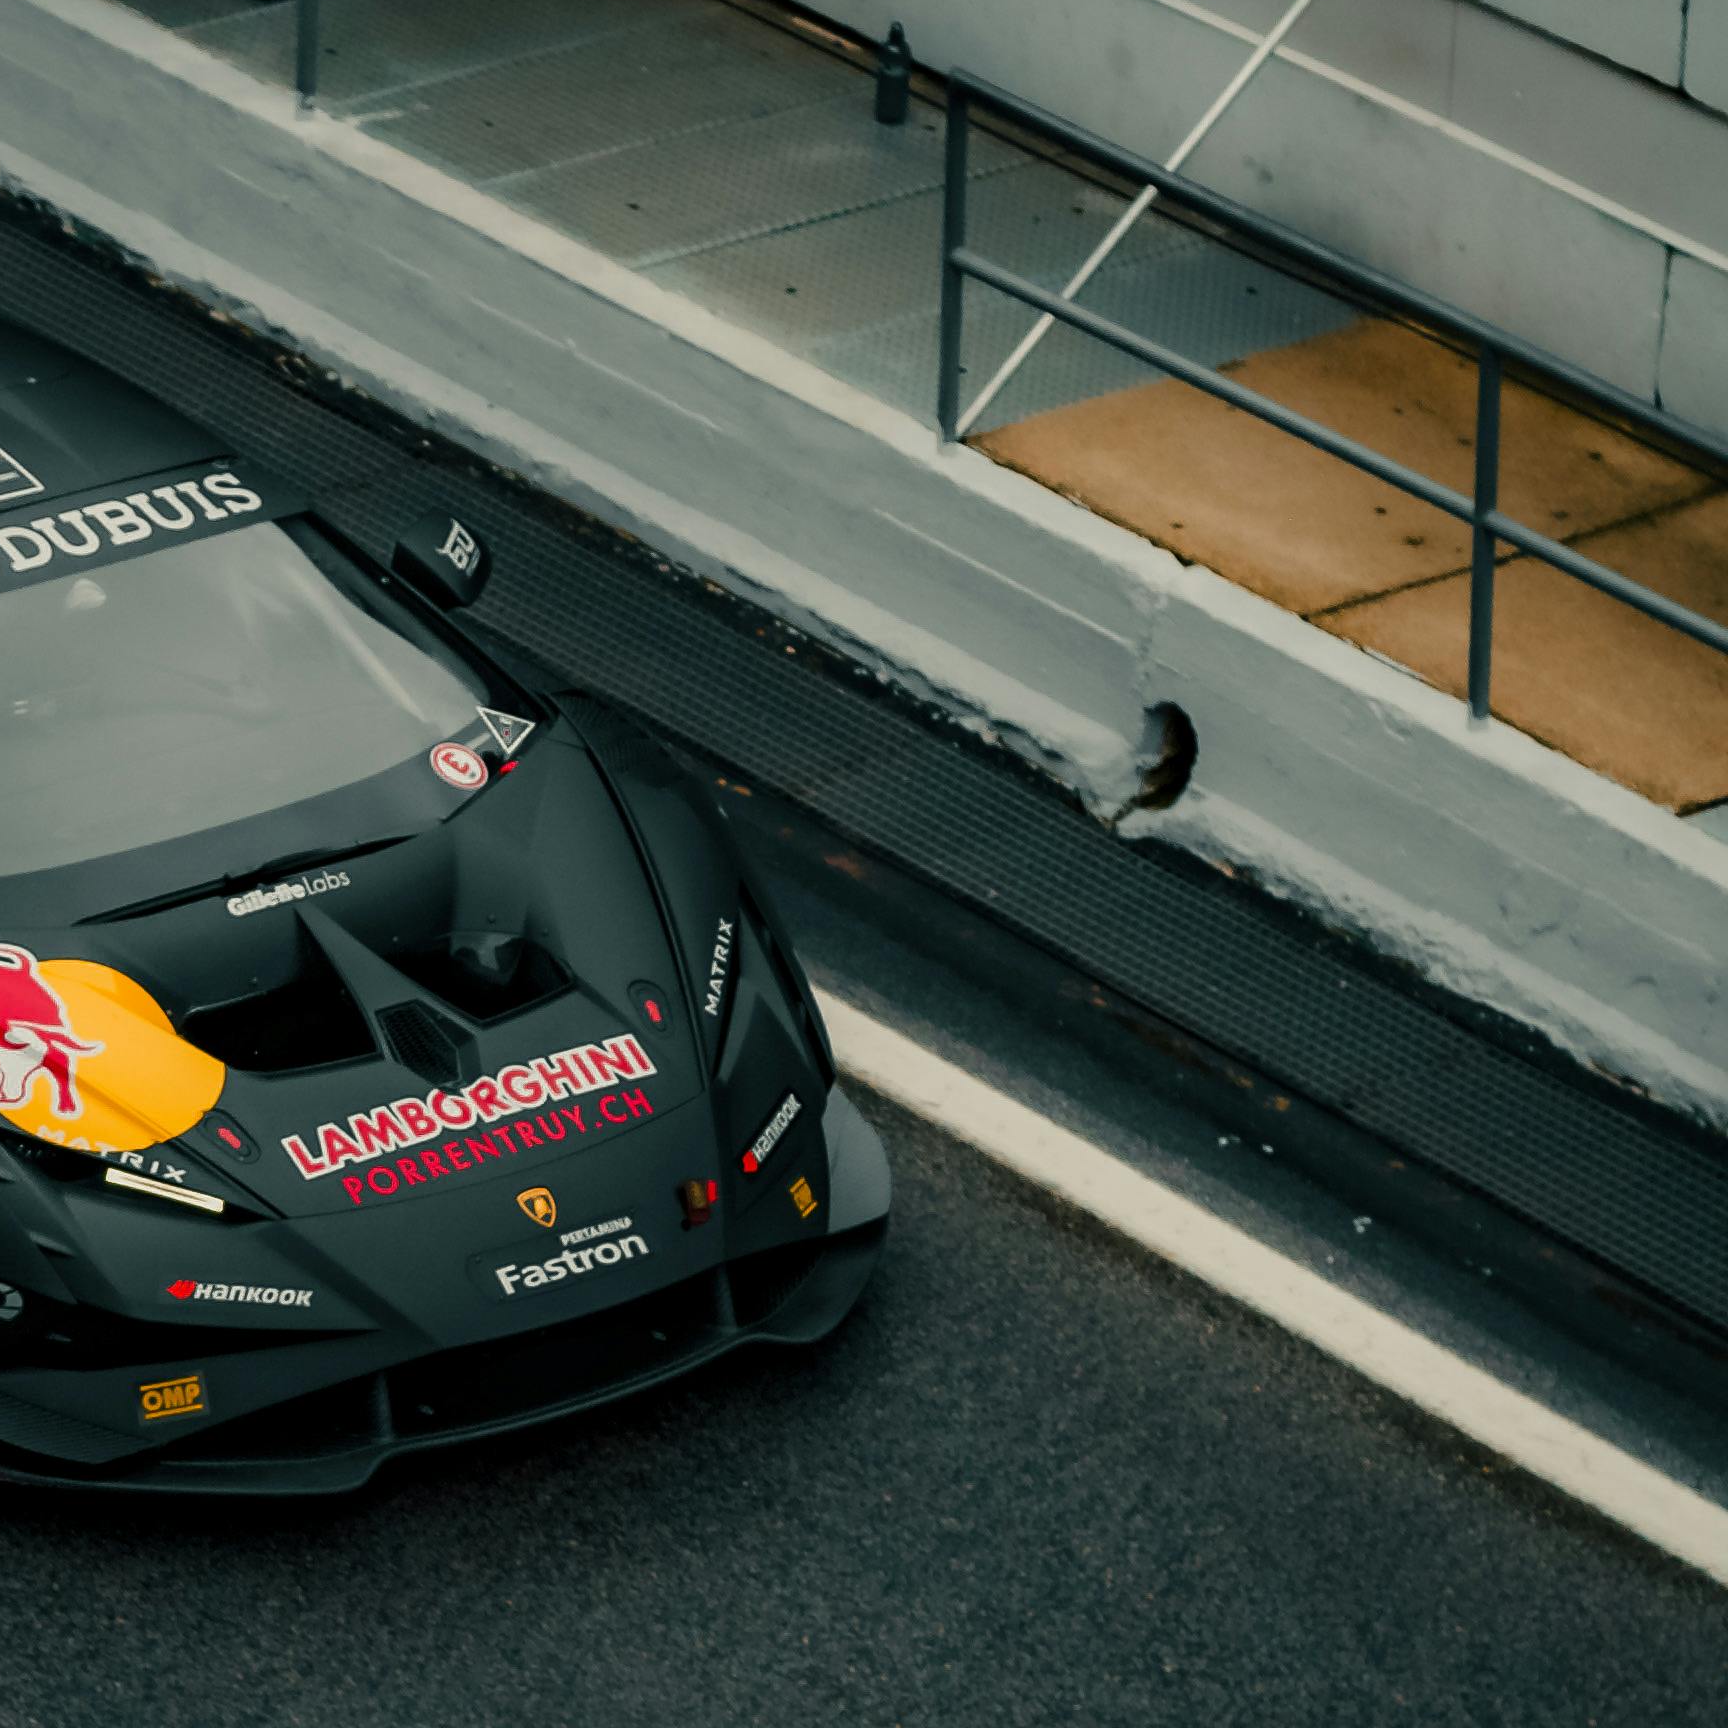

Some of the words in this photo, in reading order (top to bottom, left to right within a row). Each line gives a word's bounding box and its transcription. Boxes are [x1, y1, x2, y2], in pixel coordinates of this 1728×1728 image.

[704, 917, 734, 1016] MATRIX
[280, 1032, 658, 1182] LAMBORGHINI
[341, 1087, 655, 1207] PORRENTRUY.CH
[494, 1234, 650, 1296] Fastron
[140, 1382, 201, 1412] OMP
